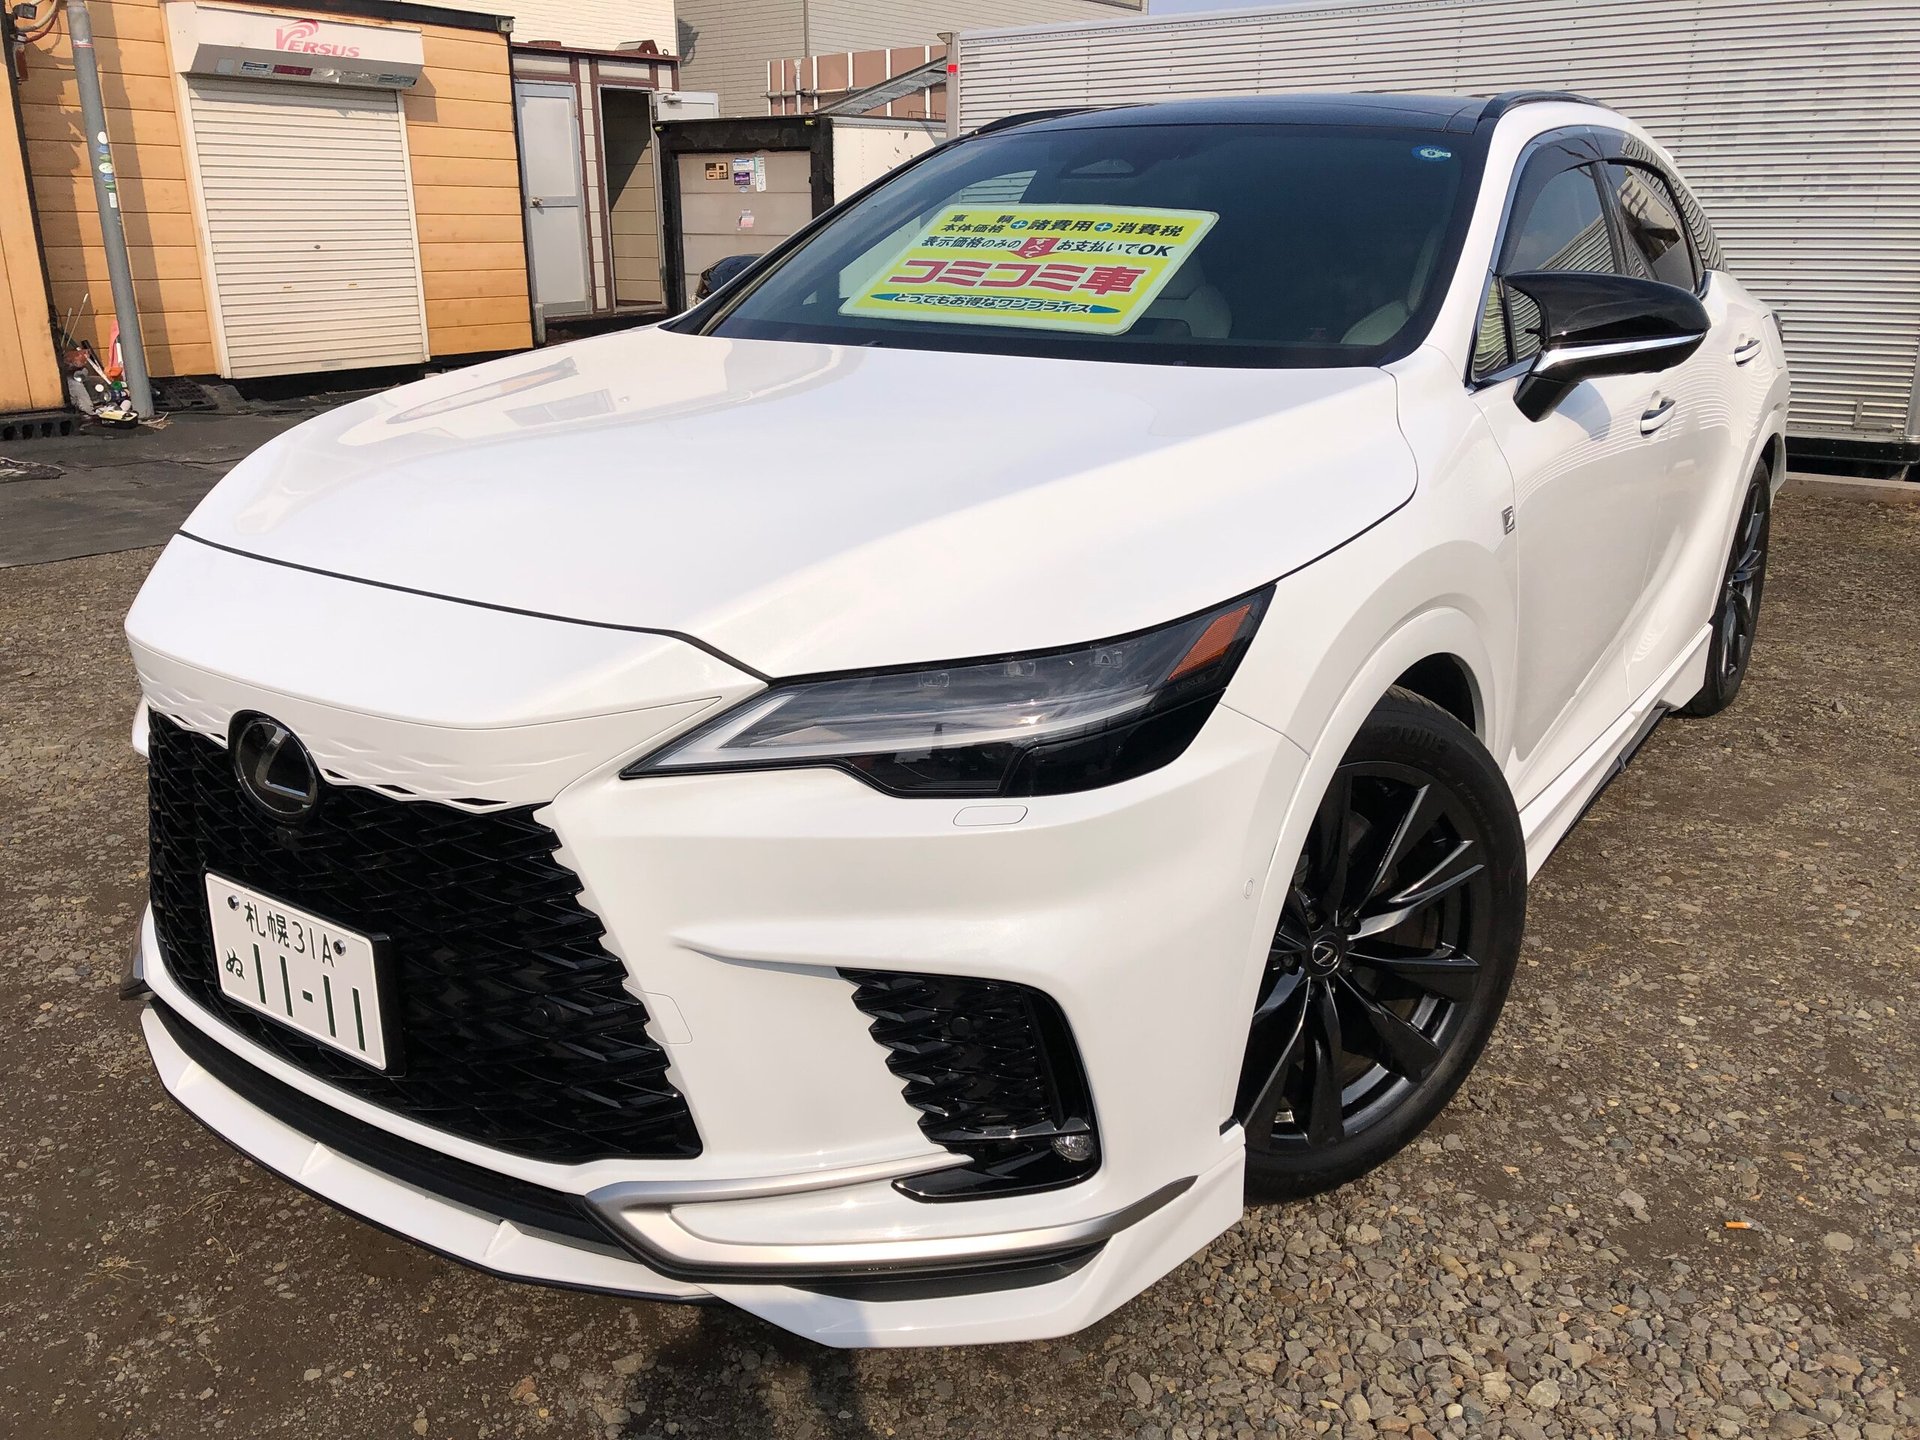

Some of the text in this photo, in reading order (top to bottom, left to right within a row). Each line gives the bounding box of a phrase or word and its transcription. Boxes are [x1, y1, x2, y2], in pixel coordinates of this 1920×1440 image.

[942, 223, 1006, 233] 本体価格
[1027, 219, 1185, 237] 諸費用 消費税
[921, 235, 1022, 249] 表示価格のみの
[1023, 238, 1051, 258] すべて
[1056, 240, 1175, 257] お支払いでOK
[889, 258, 1148, 296] コミコミ車
[225, 943, 367, 1052] ぬ 11-11
